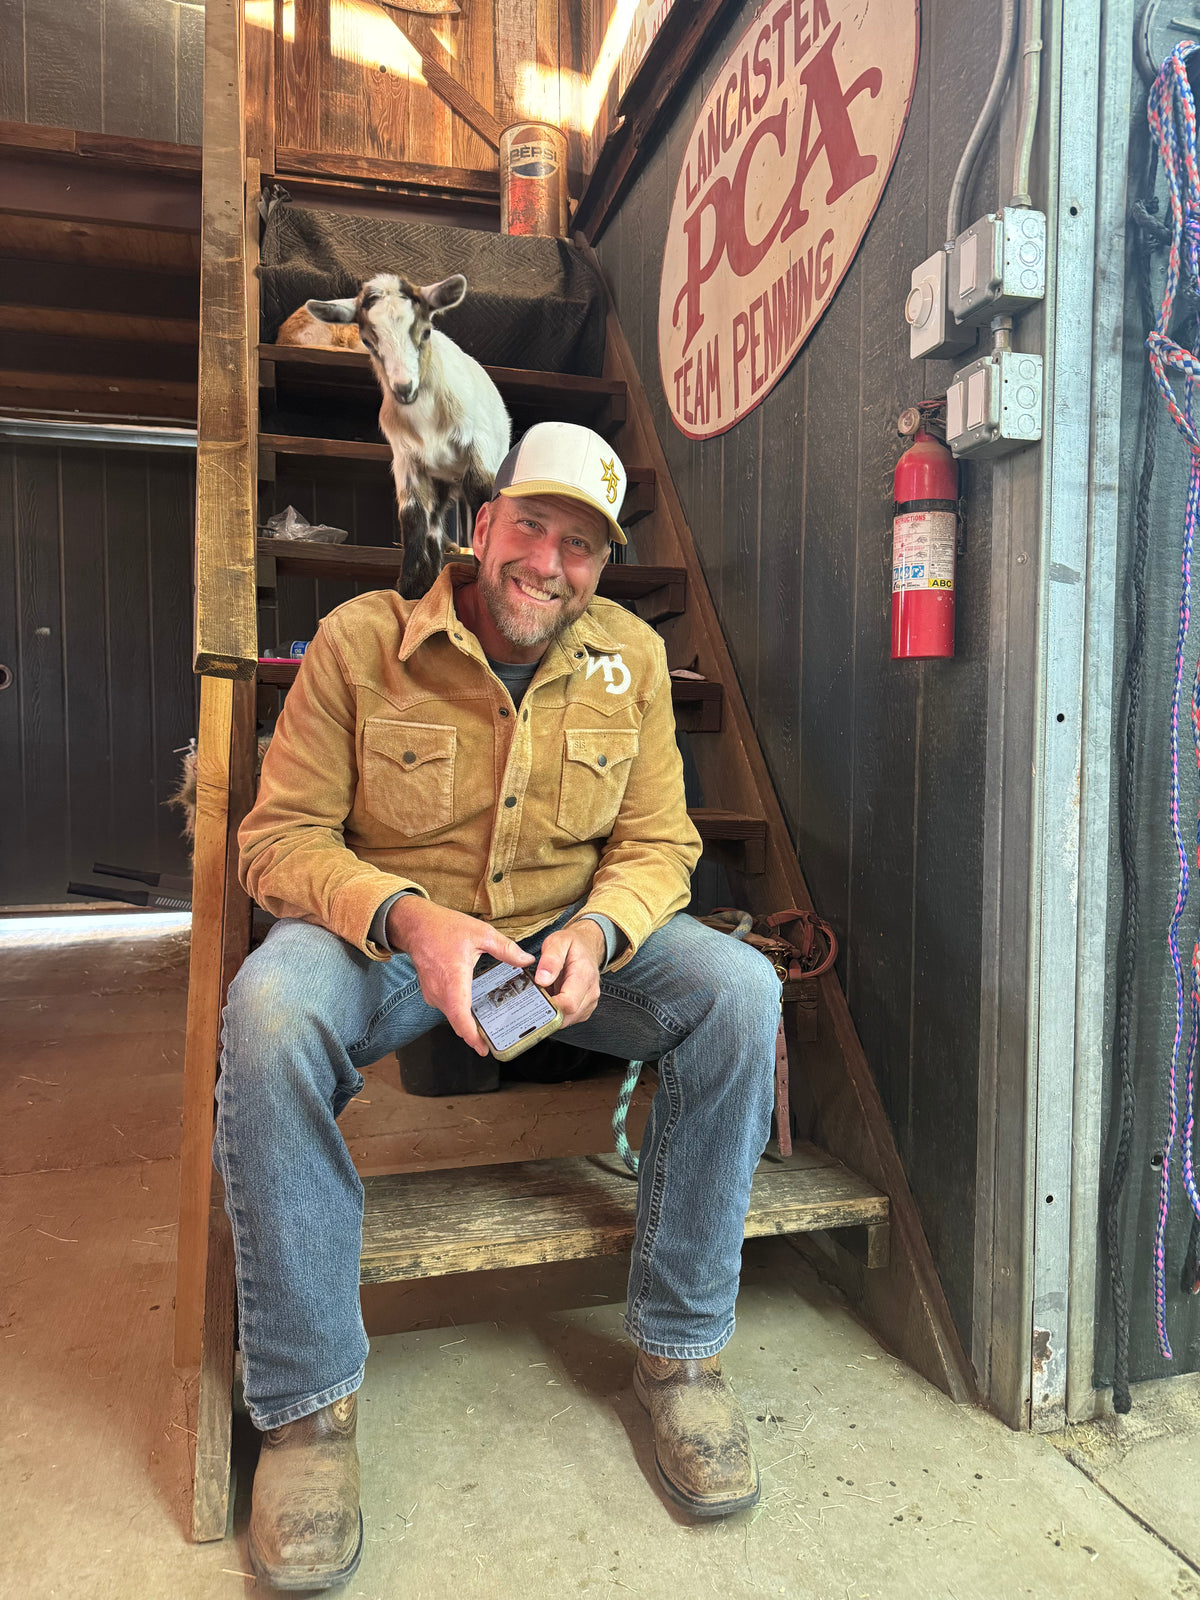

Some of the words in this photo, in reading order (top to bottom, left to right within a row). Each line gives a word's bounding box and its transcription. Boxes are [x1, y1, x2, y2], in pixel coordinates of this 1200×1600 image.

[510, 146, 557, 163] PEPSI
[672, 21, 883, 358] PCA
[674, 333, 721, 425] TEAM
[732, 228, 834, 410] PENNING
[932, 579, 952, 588] ABC
